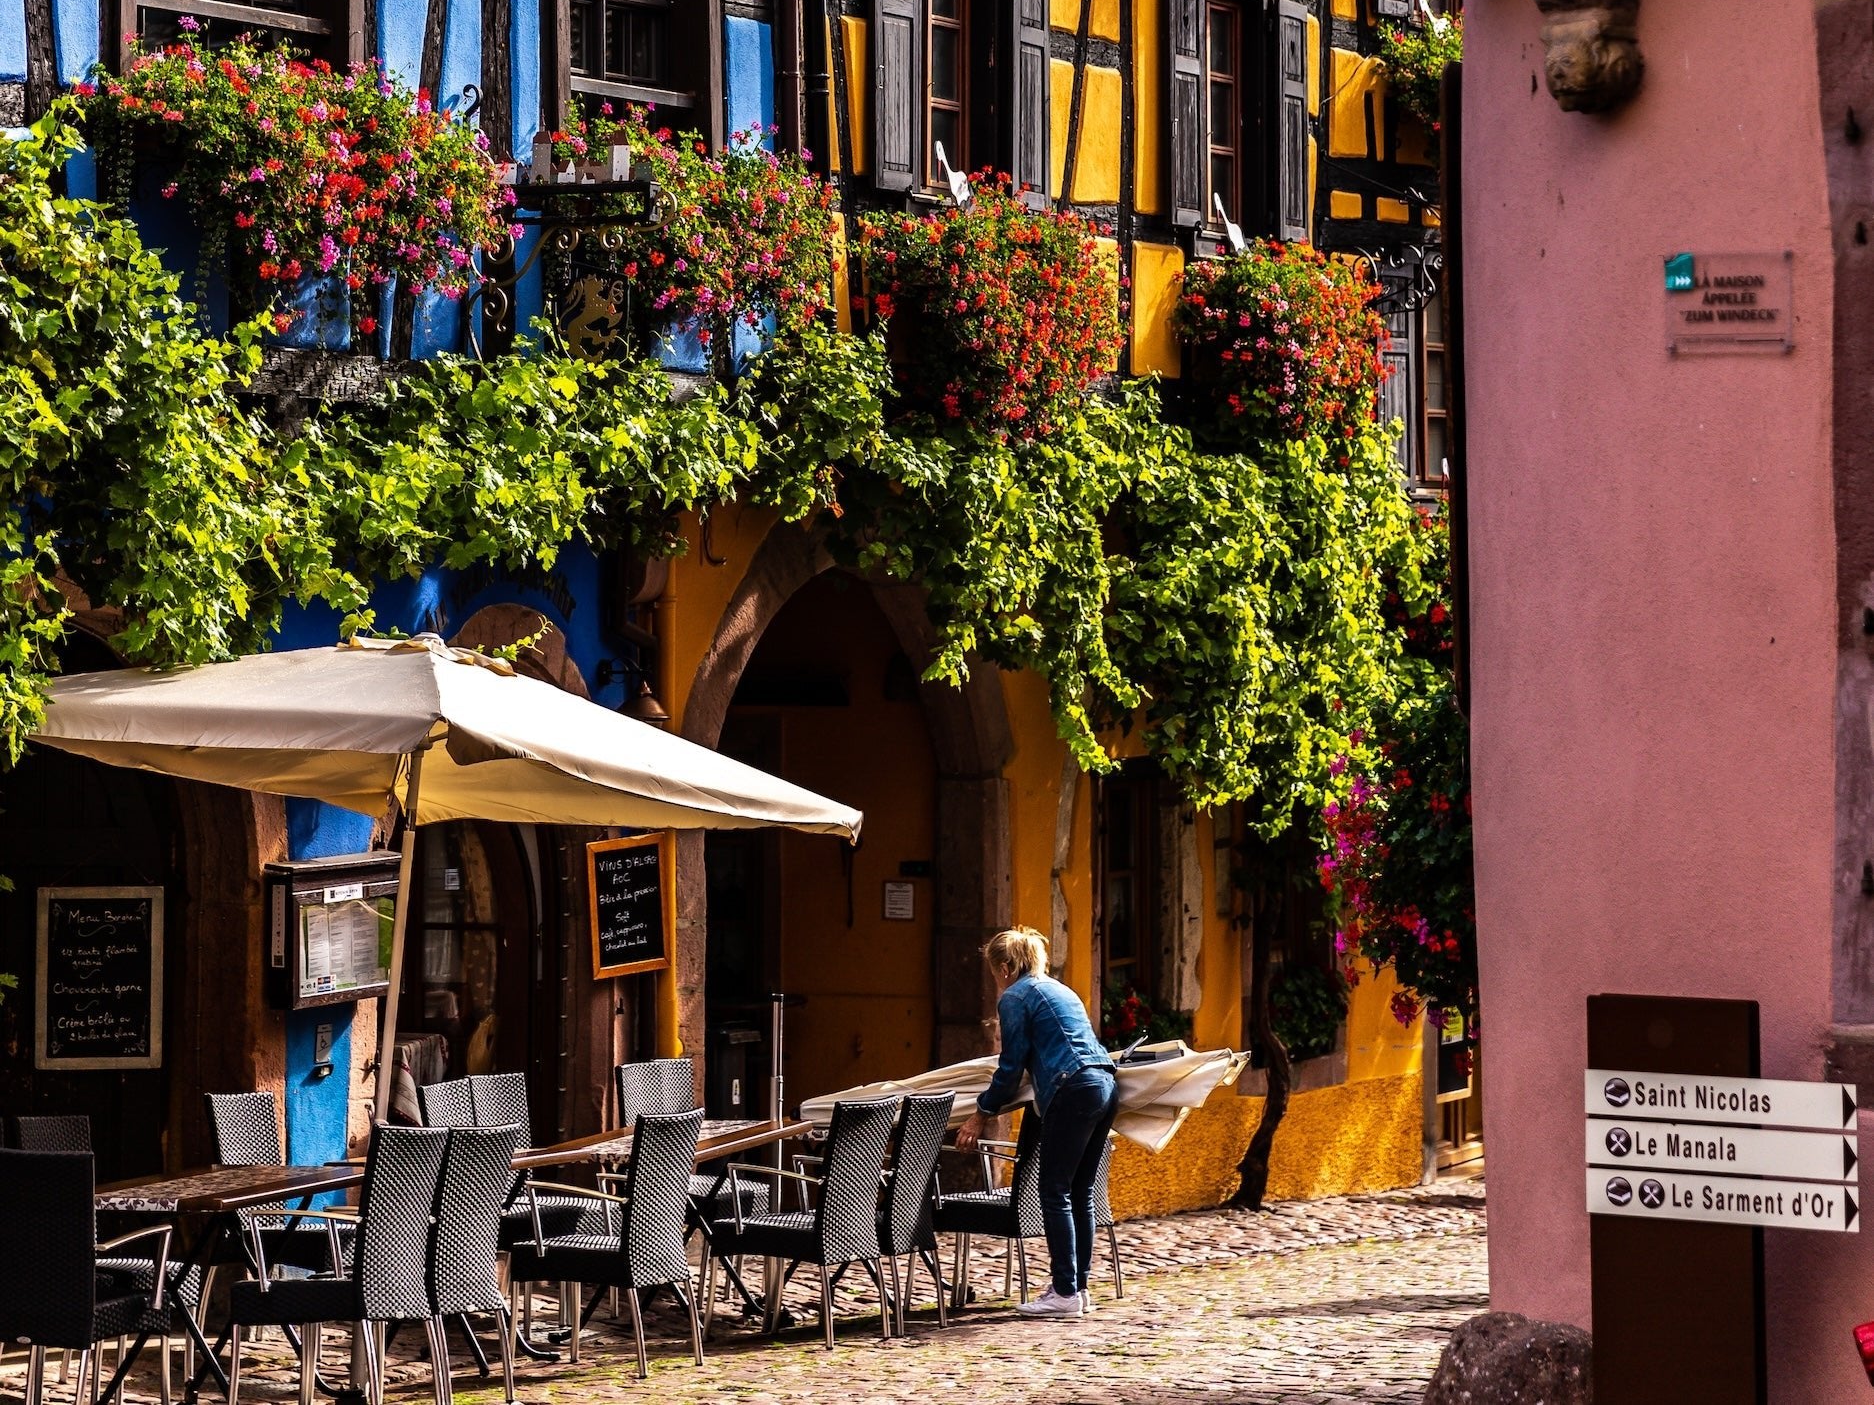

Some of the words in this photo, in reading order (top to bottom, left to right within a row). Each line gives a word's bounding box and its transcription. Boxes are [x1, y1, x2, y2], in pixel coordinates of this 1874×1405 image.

[1713, 275, 1764, 288] MAISON
[68, 909, 100, 924] Menu
[1635, 1081, 1686, 1108] Saint
[1695, 1085, 1771, 1113] Nicolas
[1635, 1131, 1657, 1156] Le
[1667, 1133, 1737, 1161] Manala
[1672, 1183, 1693, 1209] Le
[1702, 1185, 1783, 1215] Sarment
[1792, 1192, 1834, 1218] d'Or
